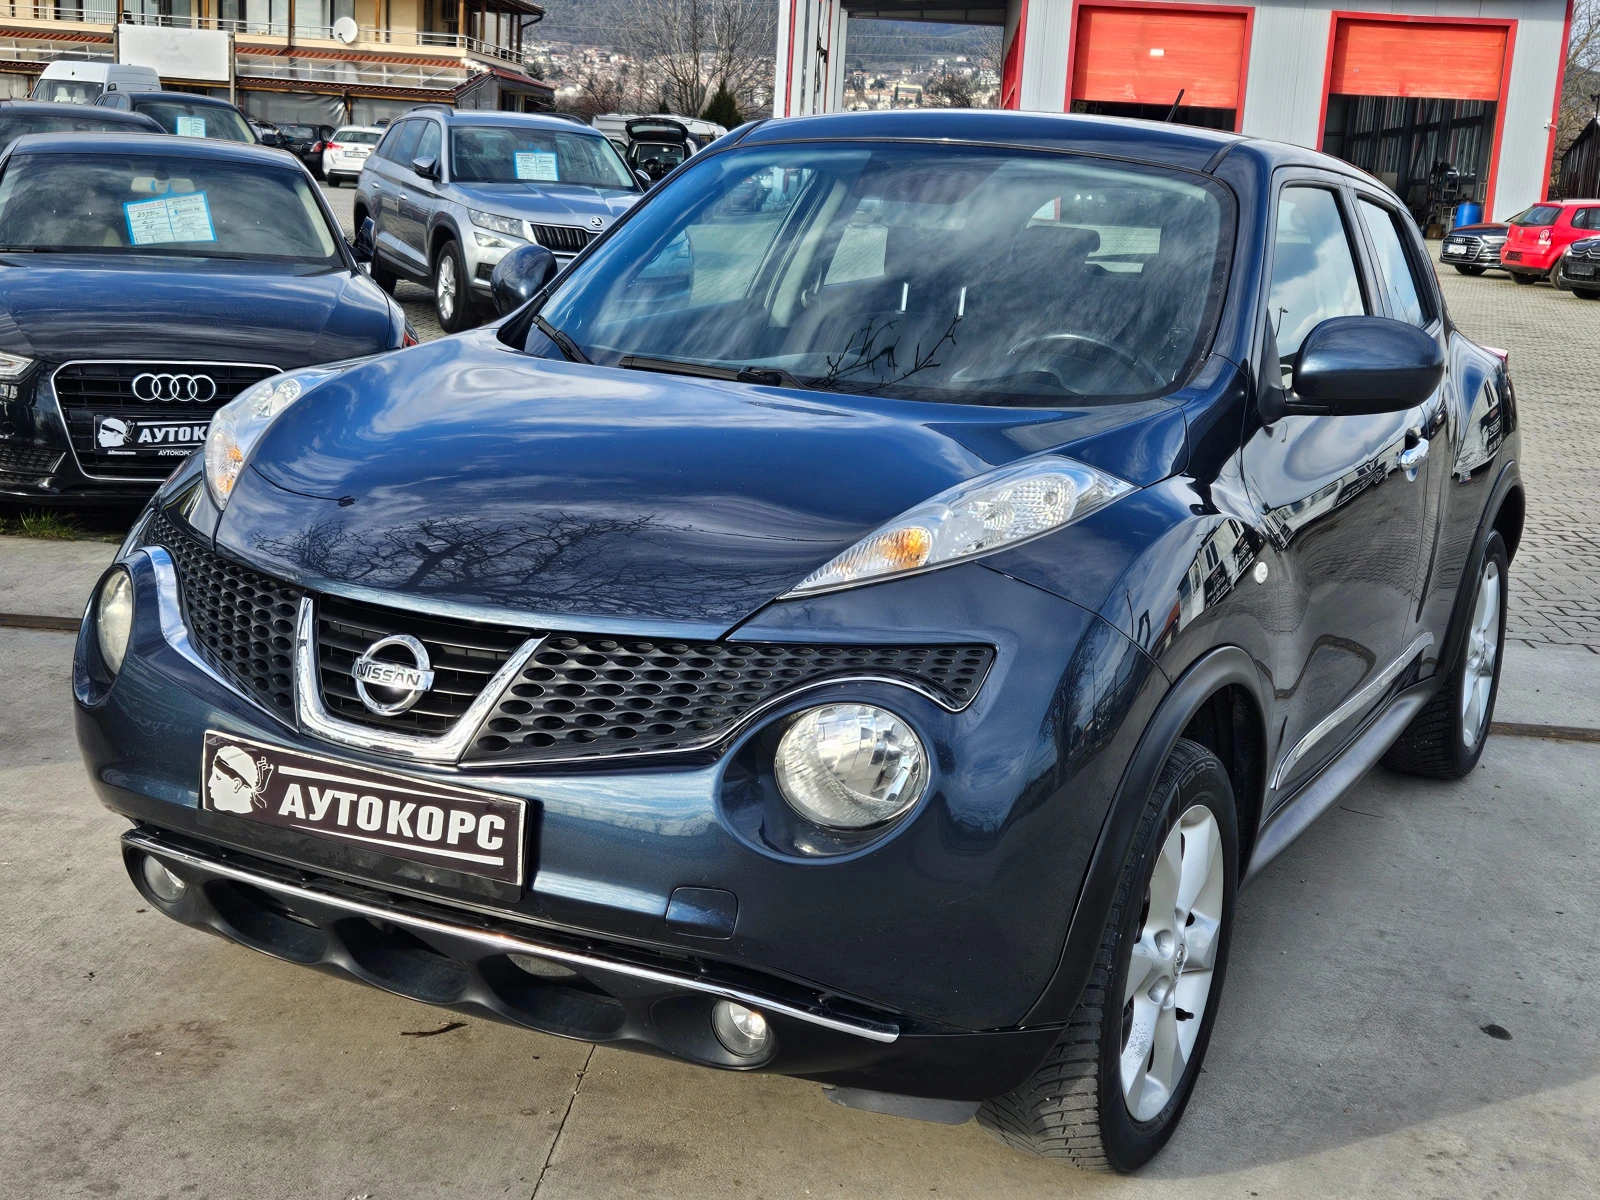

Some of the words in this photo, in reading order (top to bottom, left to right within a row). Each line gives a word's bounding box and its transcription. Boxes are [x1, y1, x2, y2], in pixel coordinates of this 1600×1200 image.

[138, 426, 207, 443] АУТОК
[357, 663, 421, 686] NISSAN
[278, 783, 505, 850] АУТОКОРС
